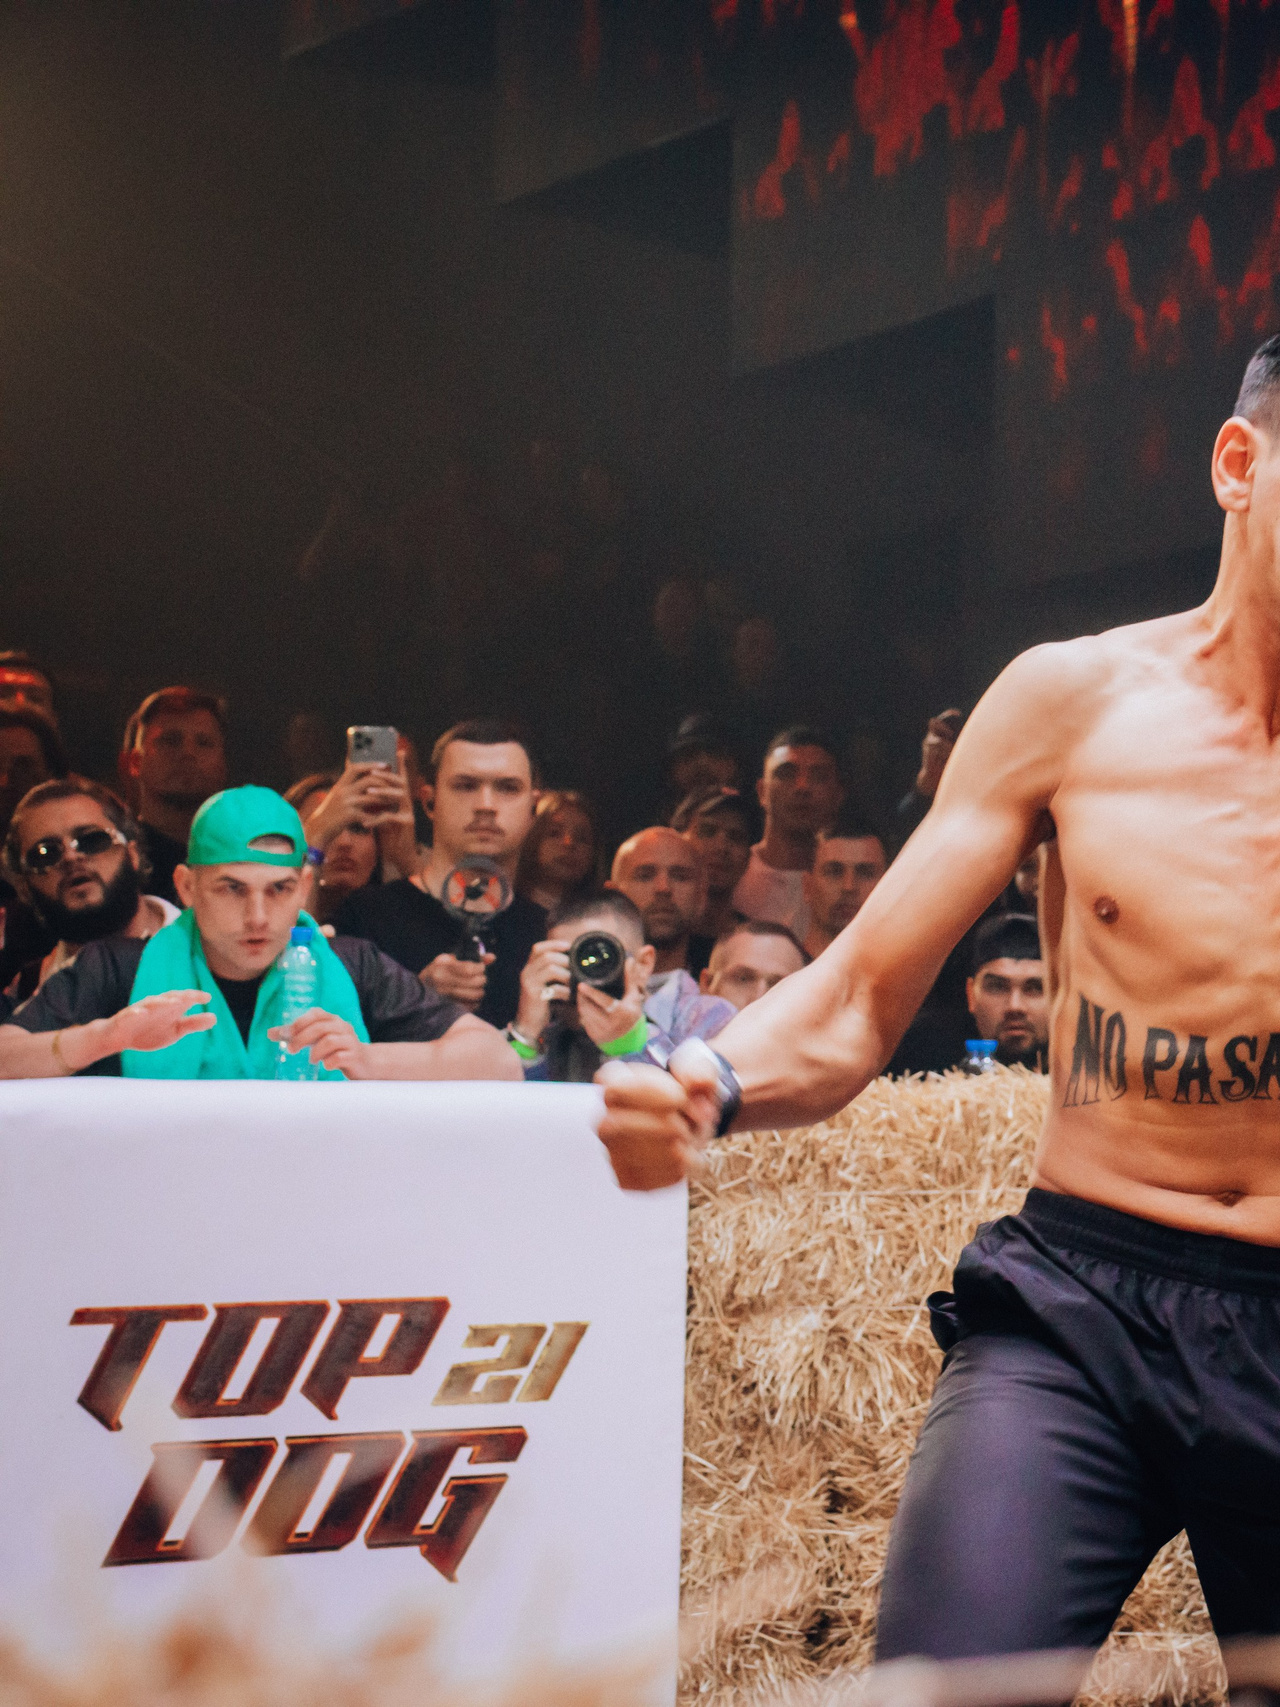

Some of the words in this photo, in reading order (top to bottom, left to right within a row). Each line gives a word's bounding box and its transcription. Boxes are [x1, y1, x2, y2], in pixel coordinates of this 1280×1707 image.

[1062, 992, 1127, 1107] NO
[69, 1296, 451, 1431] TOP
[431, 1321, 590, 1405] 21
[101, 1425, 528, 1583] DOG
